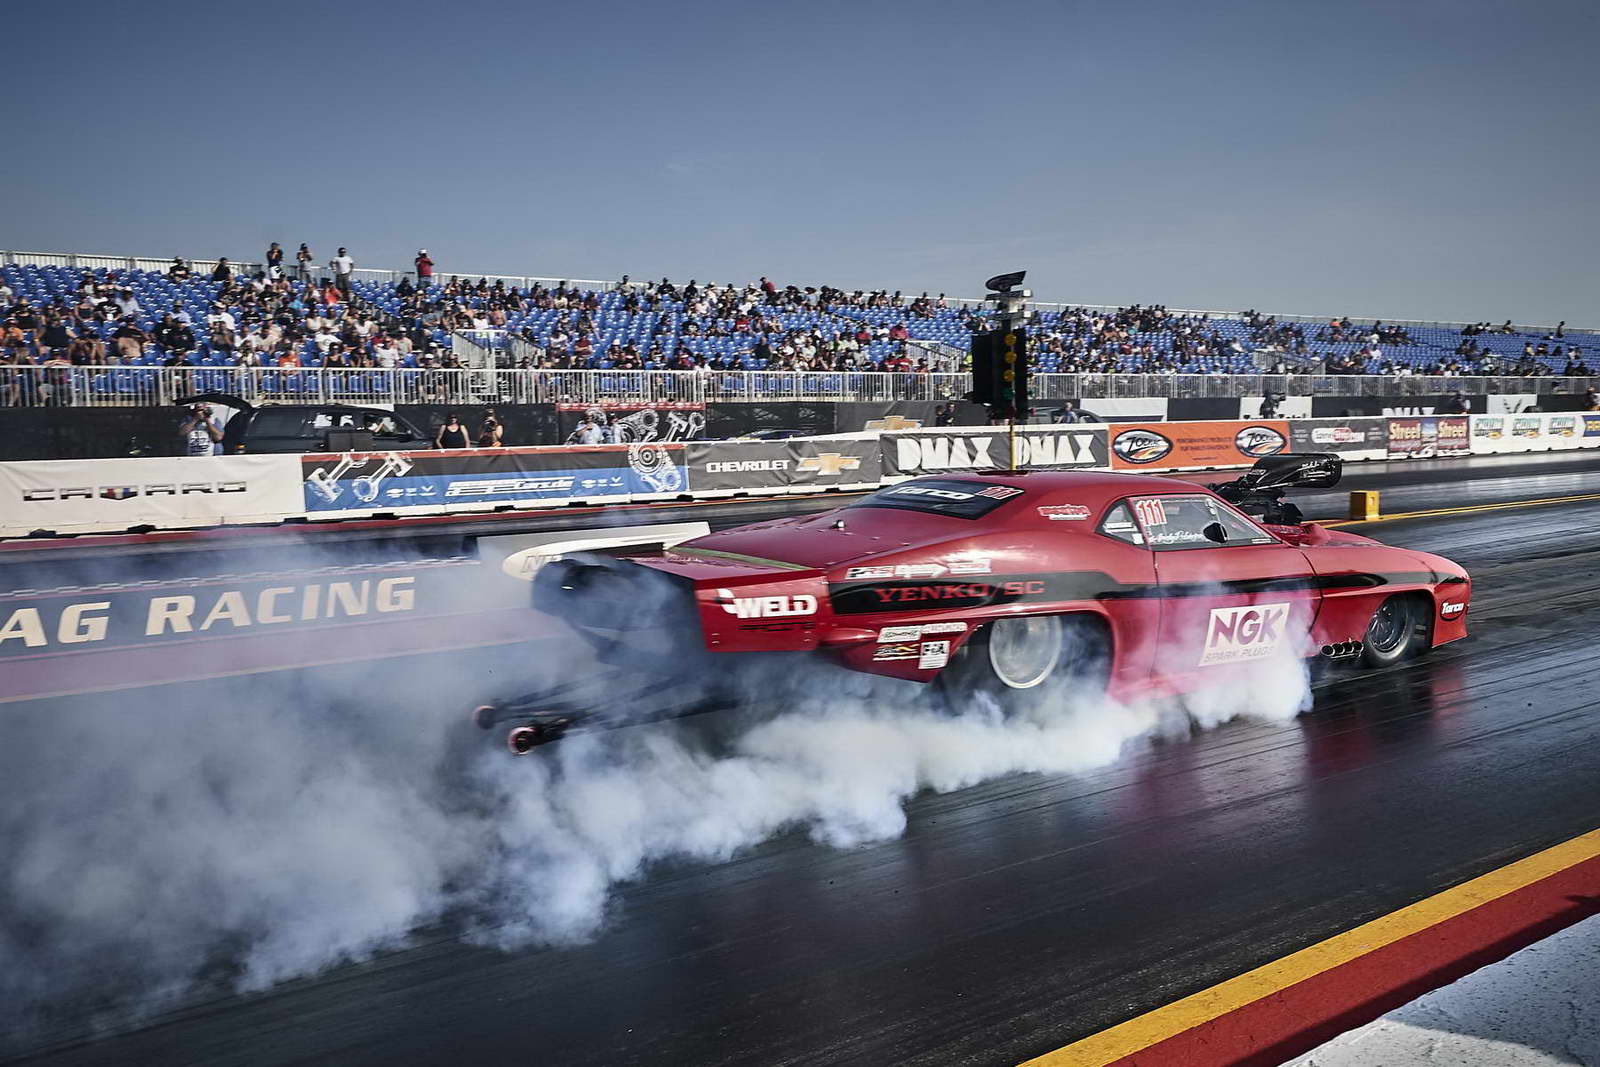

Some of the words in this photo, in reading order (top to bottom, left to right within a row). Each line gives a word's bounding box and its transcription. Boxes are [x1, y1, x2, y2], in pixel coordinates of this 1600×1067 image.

[897, 436, 995, 471] DMAX
[1015, 434, 1096, 466] DMAX
[706, 459, 790, 473] CHEVROLET
[22, 481, 248, 502] CAARO
[1137, 500, 1168, 527] 111
[0, 602, 111, 647] AG
[145, 576, 415, 636] RACING
[734, 594, 818, 619] WELD
[1208, 608, 1284, 648] NGK
